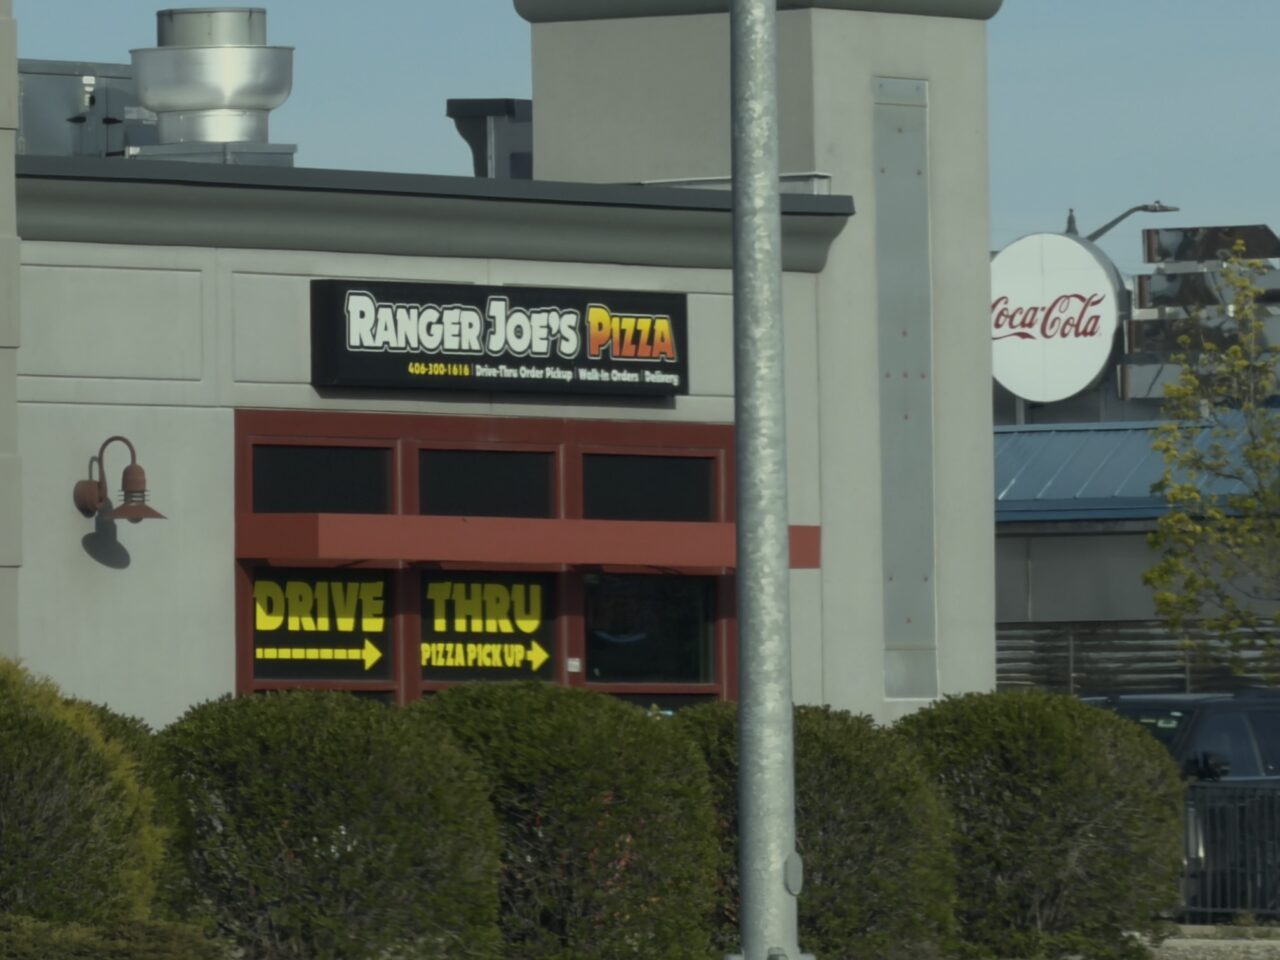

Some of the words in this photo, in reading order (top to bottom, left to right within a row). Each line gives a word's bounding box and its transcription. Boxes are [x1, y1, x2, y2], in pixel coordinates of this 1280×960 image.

[346, 290, 484, 354] RANGER
[486, 296, 579, 358] JOE'S
[586, 304, 677, 361] PIZZA
[408, 362, 470, 377] 406-300-1616
[475, 365, 518, 380] Drive-Thru
[519, 366, 544, 380] Order
[546, 366, 573, 383] Pickup
[611, 369, 639, 383] Orders
[644, 370, 680, 387] Delivery
[253, 580, 385, 632] DRIVE
[427, 581, 542, 634] THRU
[420, 642, 465, 667] PIZZA
